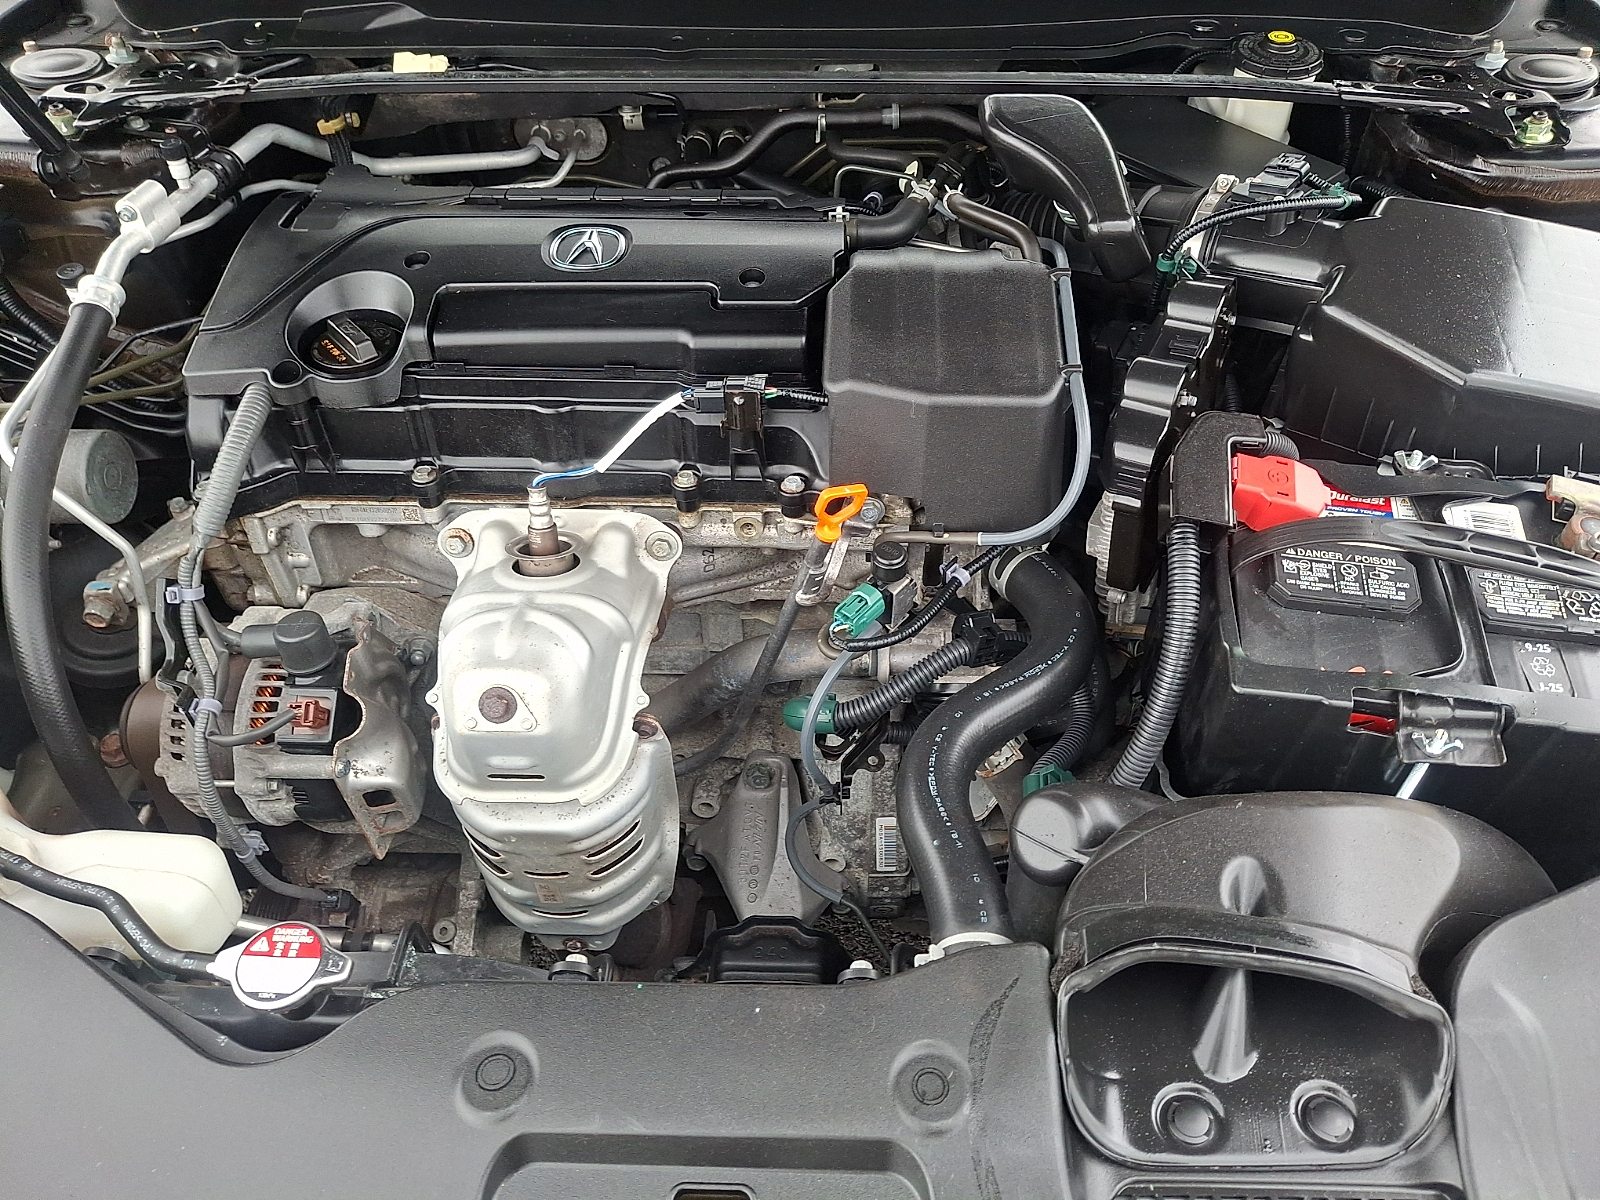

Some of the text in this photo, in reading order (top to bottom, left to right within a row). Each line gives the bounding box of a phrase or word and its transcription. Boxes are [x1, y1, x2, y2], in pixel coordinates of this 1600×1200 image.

[1326, 505, 1386, 516] PROVEN TOUGH
[1297, 548, 1343, 561] DANGER
[1354, 555, 1397, 566] POISON
[273, 927, 309, 936] DANGER
[271, 934, 314, 944] WARNING
